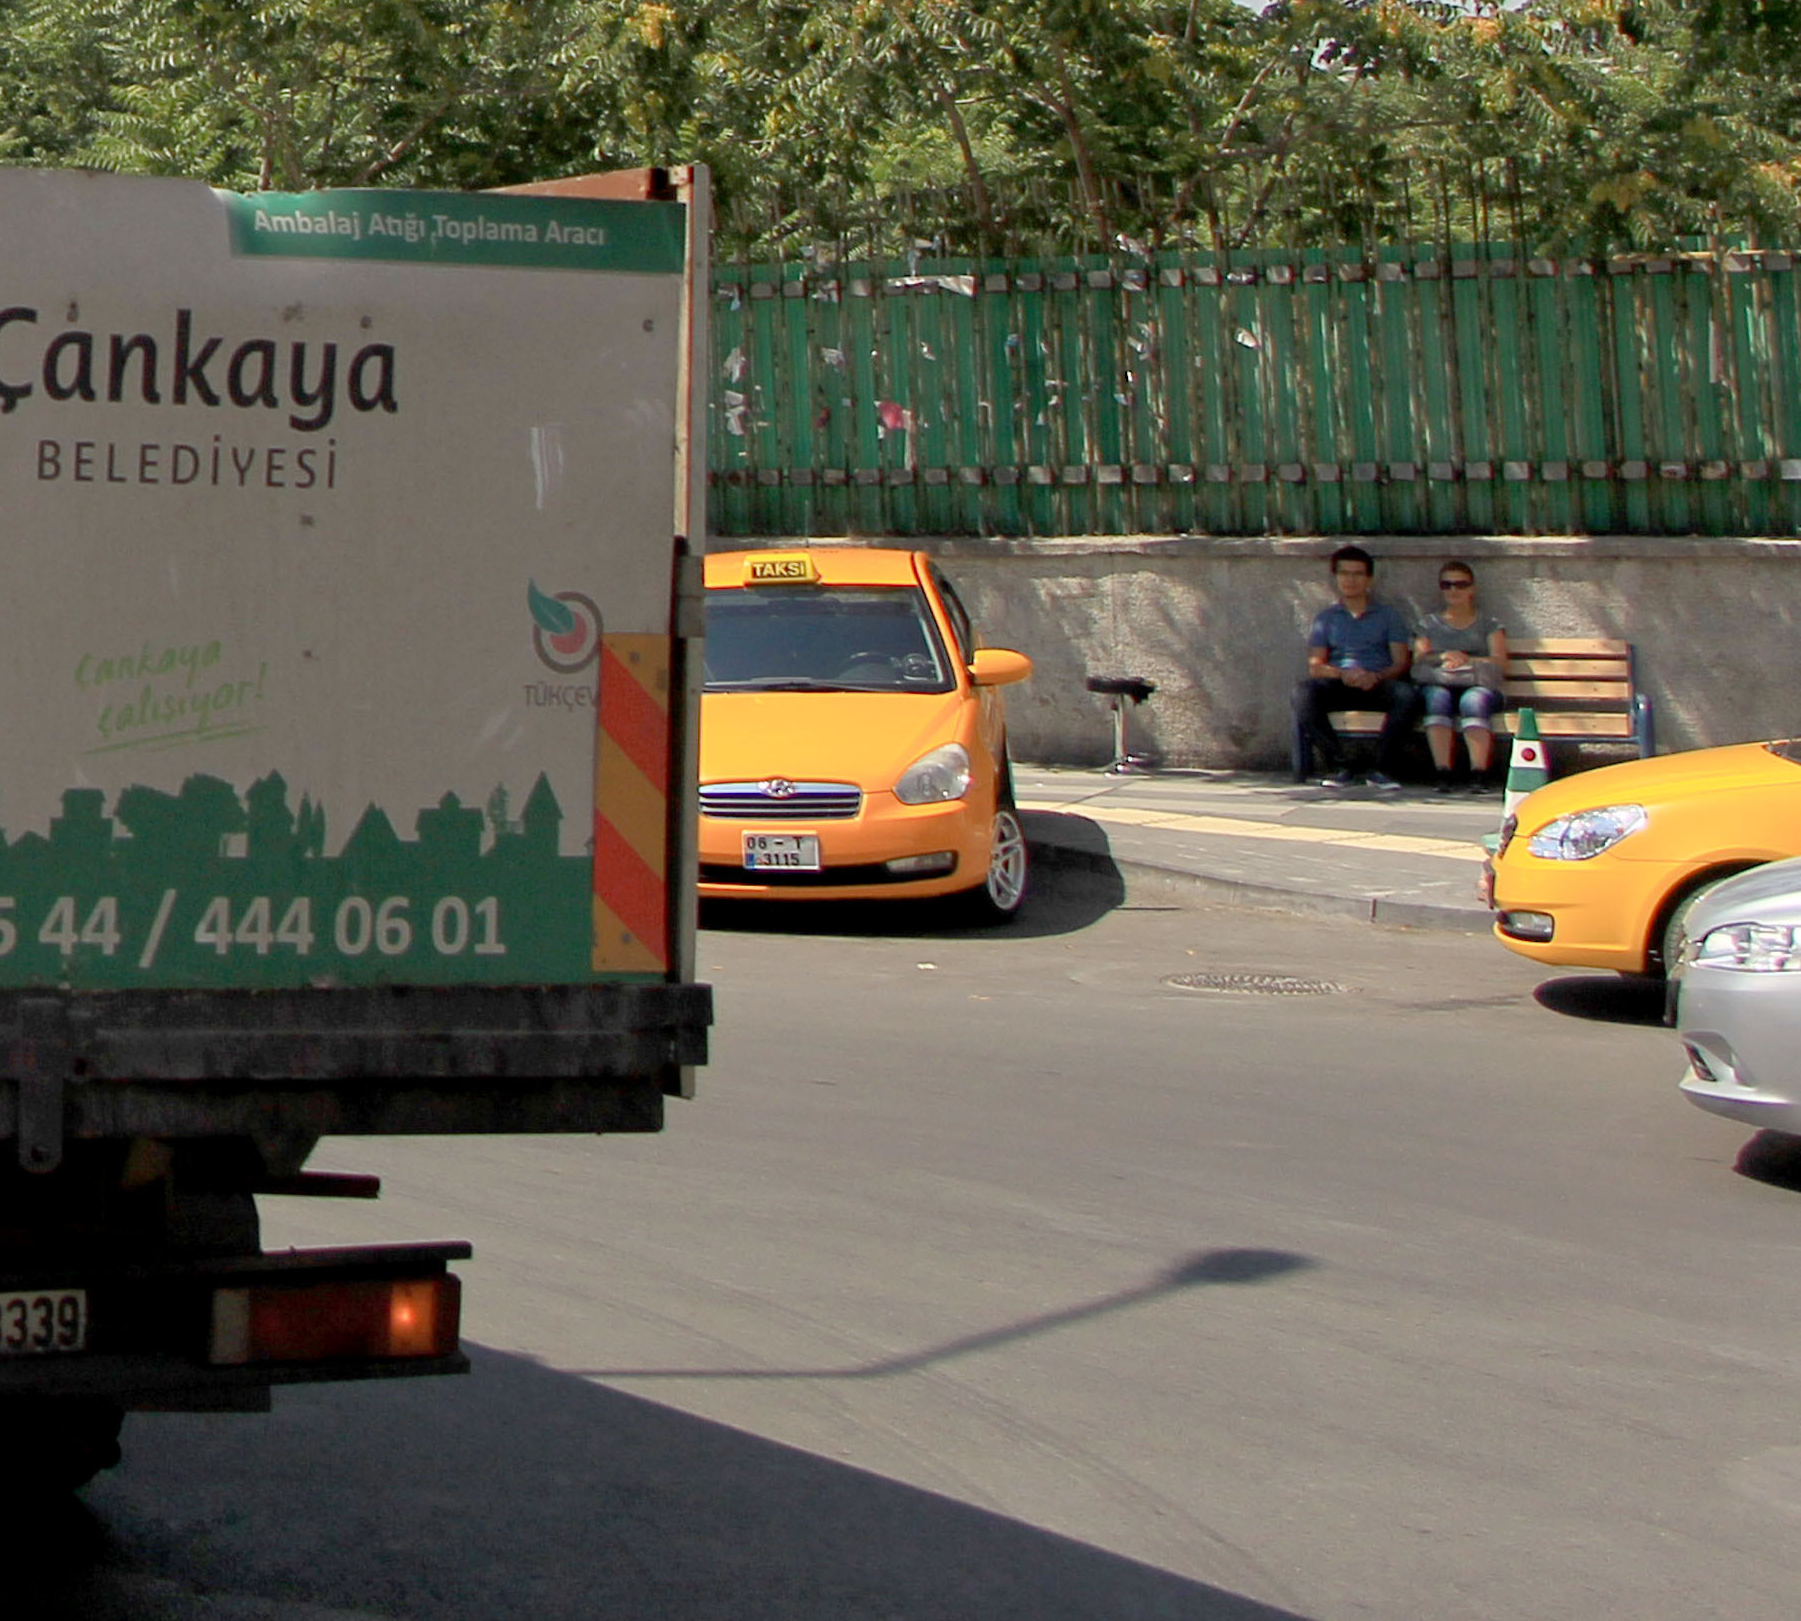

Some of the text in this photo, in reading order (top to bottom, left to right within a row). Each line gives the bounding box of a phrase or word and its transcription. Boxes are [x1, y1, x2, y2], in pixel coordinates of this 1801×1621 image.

[254, 209, 361, 240] Ambalaj
[432, 215, 539, 245] Toplama
[37, 434, 337, 489] BELEDİYESİ
[38, 896, 120, 956] 44
[194, 896, 314, 955] 444
[334, 896, 412, 955] 06
[431, 896, 506, 955] 01
